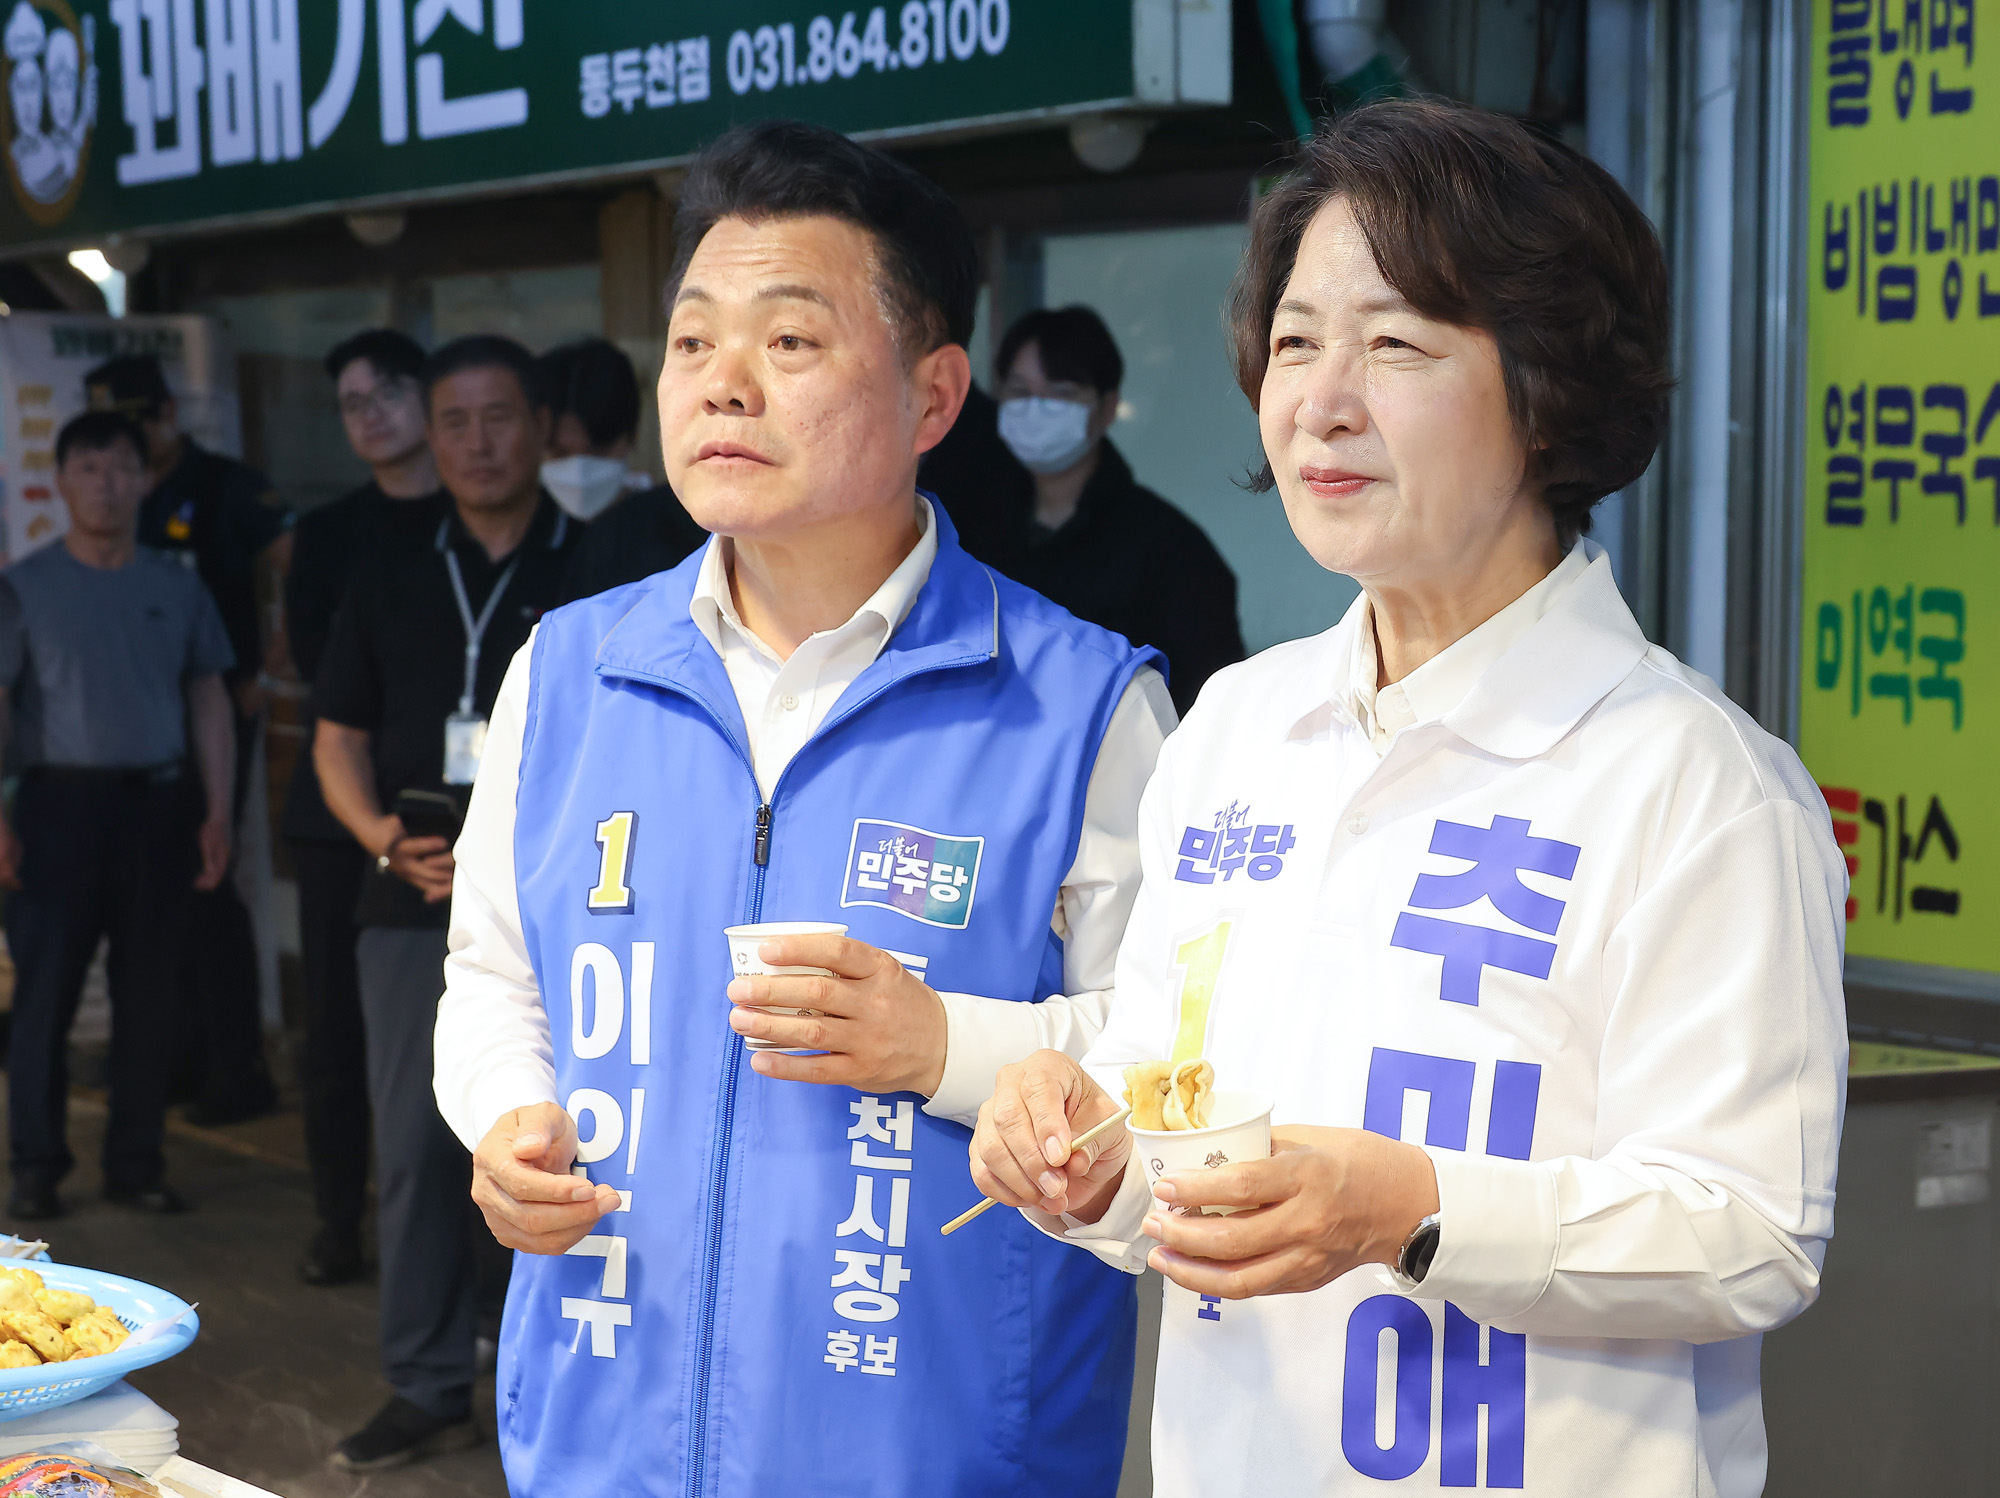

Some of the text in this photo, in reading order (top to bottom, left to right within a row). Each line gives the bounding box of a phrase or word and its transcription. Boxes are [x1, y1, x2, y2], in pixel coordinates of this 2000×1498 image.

[580, 0, 1010, 118] 동두천점 031.864.8100
[1816, 583, 1966, 732] 미역국
[1214, 799, 1250, 829] 더불어
[588, 811, 640, 915] 1
[878, 836, 919, 858] 더불어
[1175, 825, 1296, 884] 민주당
[857, 851, 969, 903] 민주당
[823, 1329, 897, 1377] 후보
